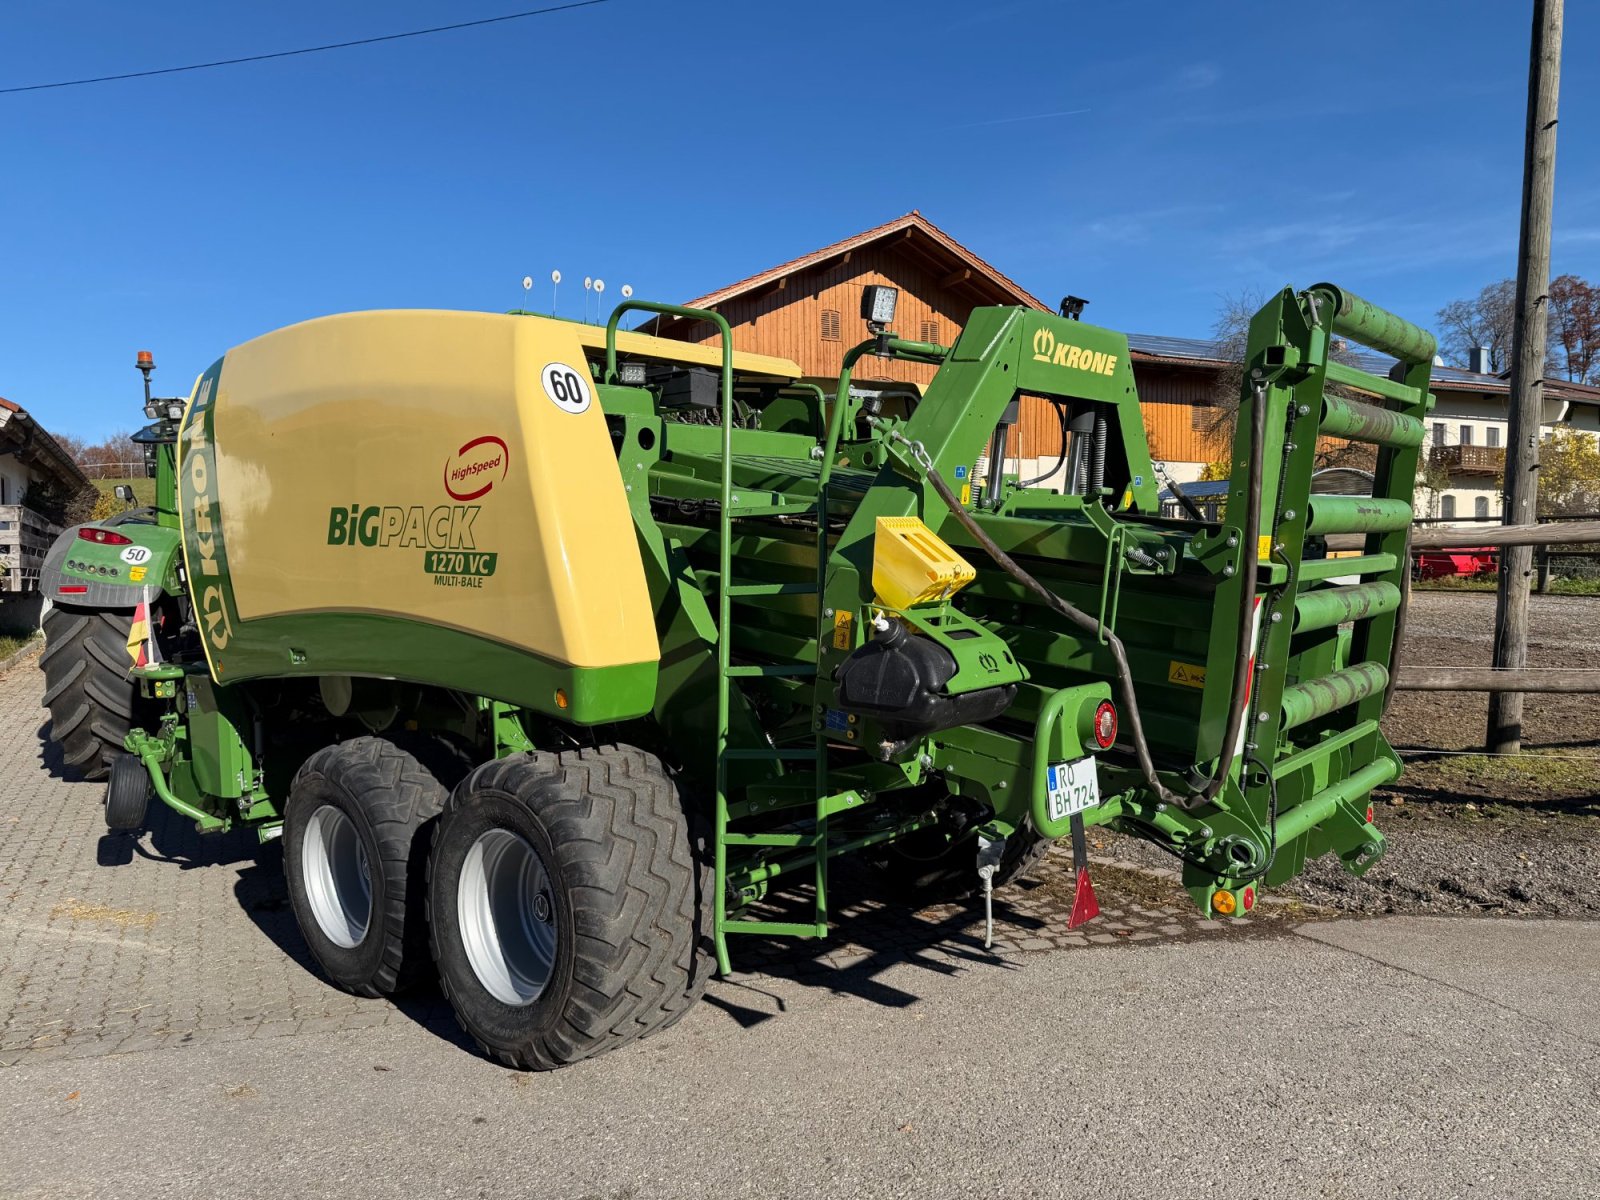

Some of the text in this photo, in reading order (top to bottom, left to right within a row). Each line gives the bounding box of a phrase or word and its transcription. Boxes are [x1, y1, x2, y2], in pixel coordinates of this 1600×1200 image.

[1053, 342, 1118, 377] KRONE
[550, 370, 583, 404] 60
[191, 377, 219, 576] KRONE
[451, 454, 502, 481] HighSpeed
[126, 548, 146, 562] 50
[431, 553, 490, 574] 1270 VC
[434, 575, 483, 588] MULTI-BALE
[1059, 765, 1074, 788] RO
[1055, 779, 1095, 815] BH 724
